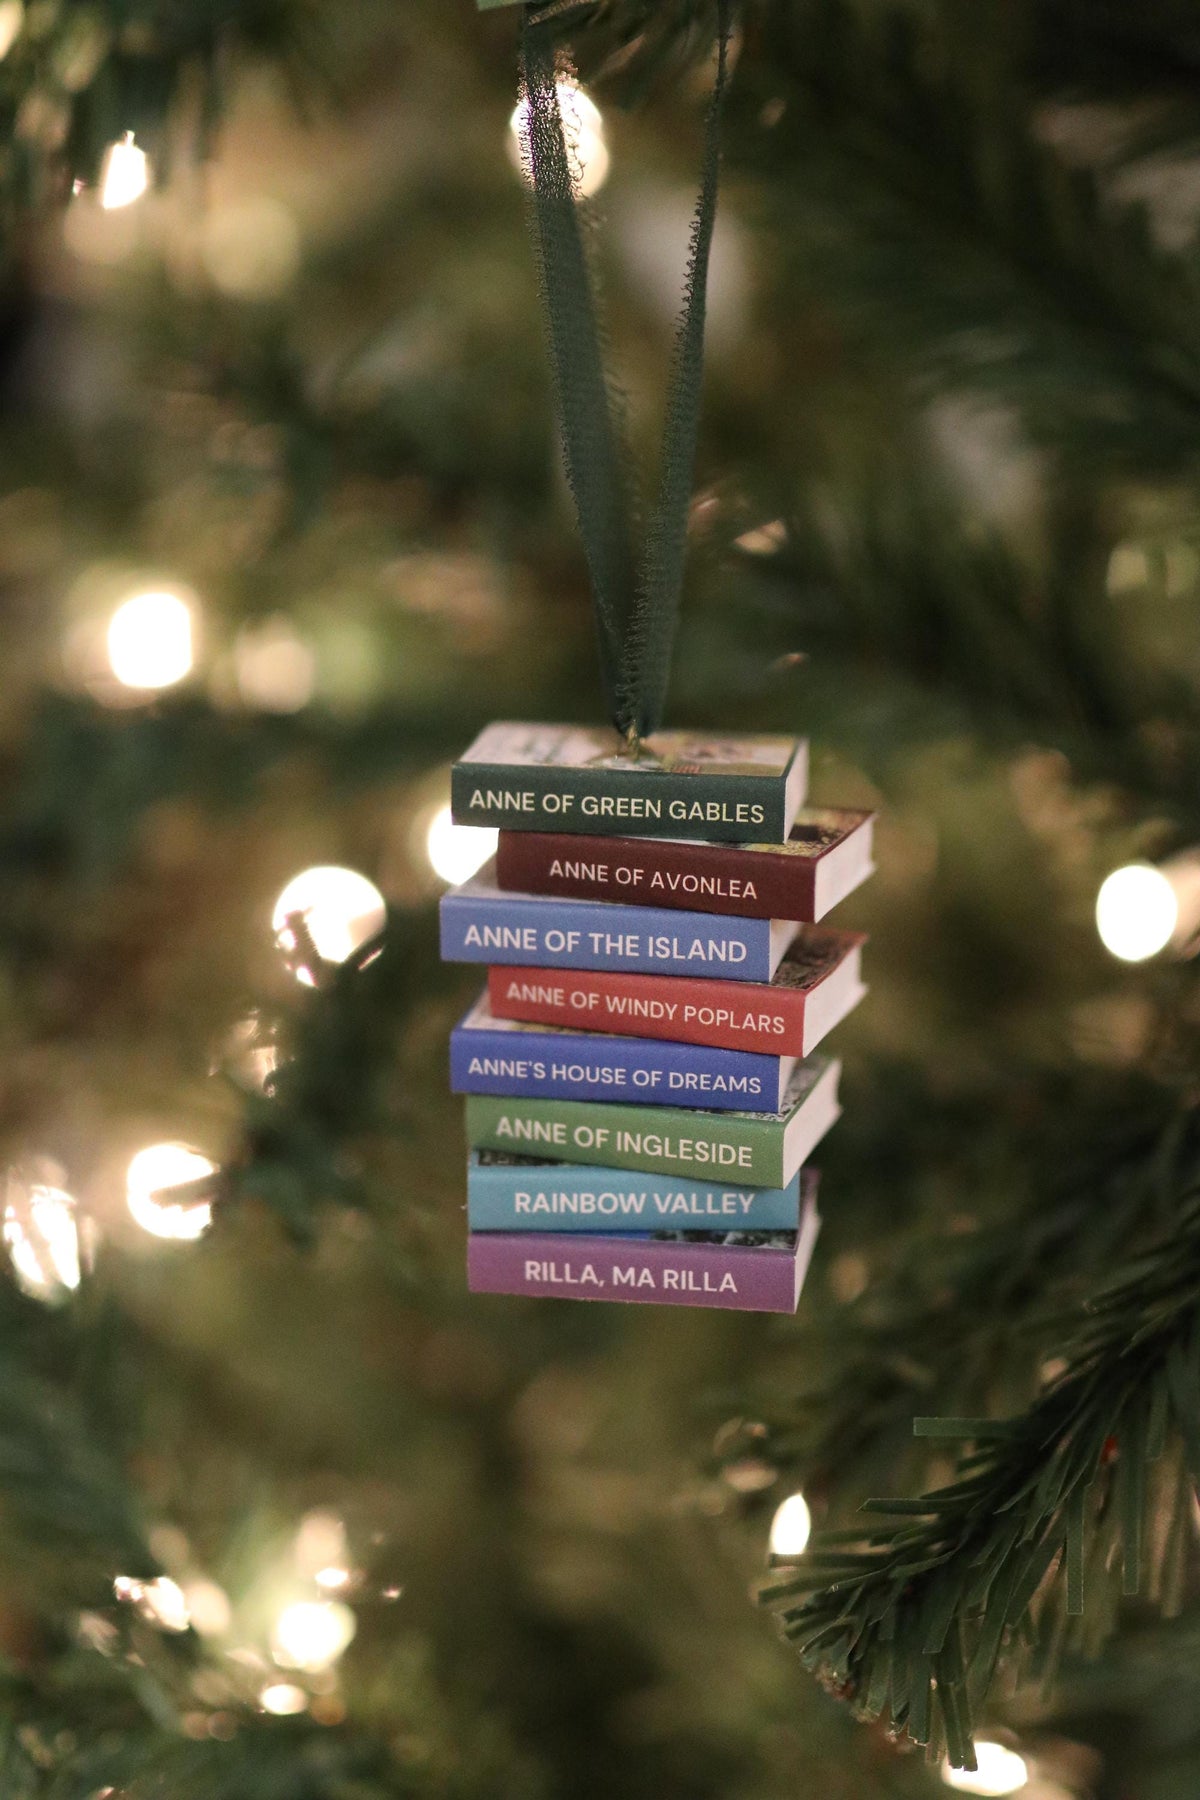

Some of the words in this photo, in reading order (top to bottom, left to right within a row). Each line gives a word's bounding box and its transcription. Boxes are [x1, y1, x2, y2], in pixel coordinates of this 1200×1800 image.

[470, 790, 535, 811] ANNE
[542, 794, 574, 813] OF
[581, 796, 661, 818] GREEN
[669, 800, 764, 823] GABLES
[549, 860, 608, 882] ANNE
[615, 867, 644, 885] OF
[650, 871, 757, 899] AVONLEA
[465, 925, 537, 950] ANNE
[545, 930, 580, 952] OF
[588, 933, 639, 956] THE
[648, 937, 746, 962] ISLAND
[507, 983, 564, 1006] ANNE
[570, 991, 599, 1010] OF
[606, 995, 678, 1021] WINDY
[684, 1006, 785, 1035] POPLARS
[468, 1058, 546, 1079] ANNE'S
[552, 1064, 626, 1085] HOUSE
[632, 1070, 662, 1087] OF
[669, 1072, 761, 1094] DREAMS
[496, 1117, 566, 1143] ANNE
[574, 1126, 609, 1148] OF
[617, 1131, 753, 1168] INGLESIDE
[514, 1192, 646, 1214] RAINBOW
[653, 1193, 755, 1214] VALLEY
[525, 1261, 605, 1287] RILLA,
[612, 1266, 656, 1288] MA
[663, 1269, 738, 1292] RILLA
